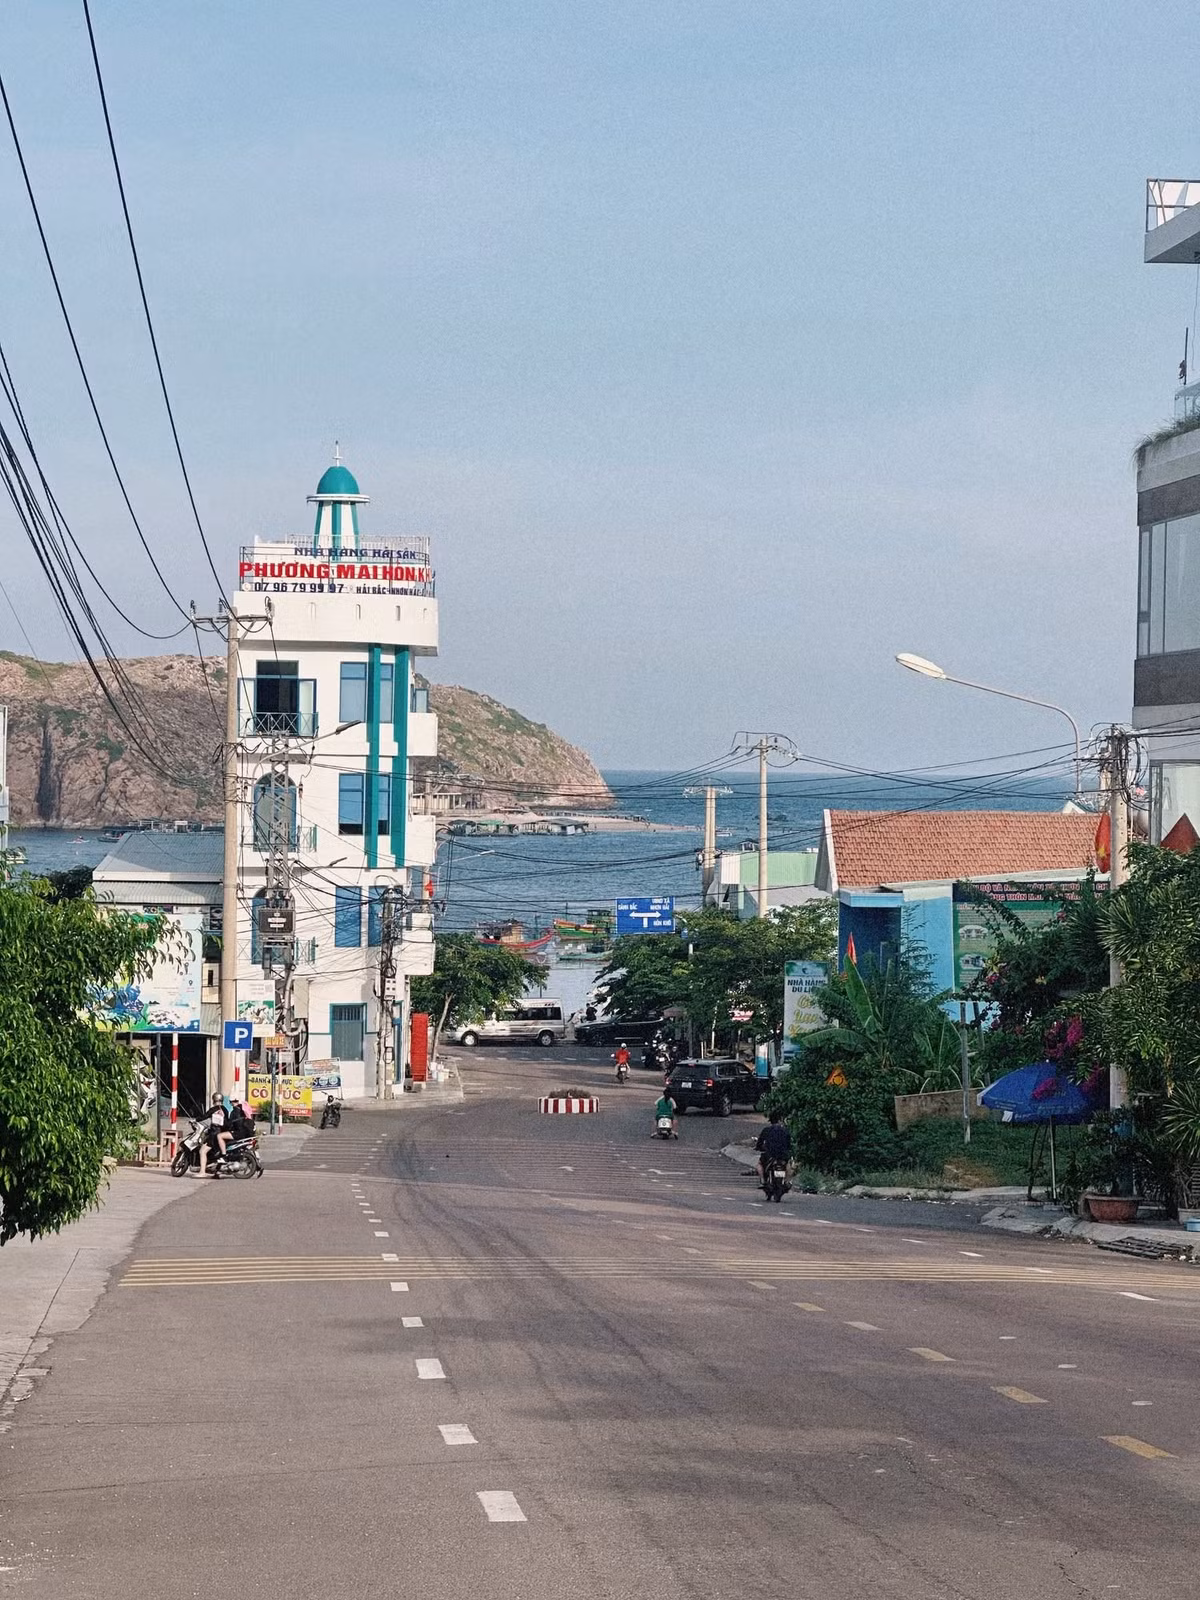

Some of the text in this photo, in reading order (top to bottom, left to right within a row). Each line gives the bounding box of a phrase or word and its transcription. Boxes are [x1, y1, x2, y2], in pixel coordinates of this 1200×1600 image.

[239, 560, 331, 579] PHƯƠNG
[336, 563, 379, 580] MAI
[273, 582, 288, 593] 96
[291, 583, 307, 593] 79
[309, 583, 325, 593] 99
[328, 583, 345, 594] 97
[787, 977, 804, 986] NHÀ
[234, 1027, 249, 1044] P
[251, 1086, 269, 1099] CÔ
